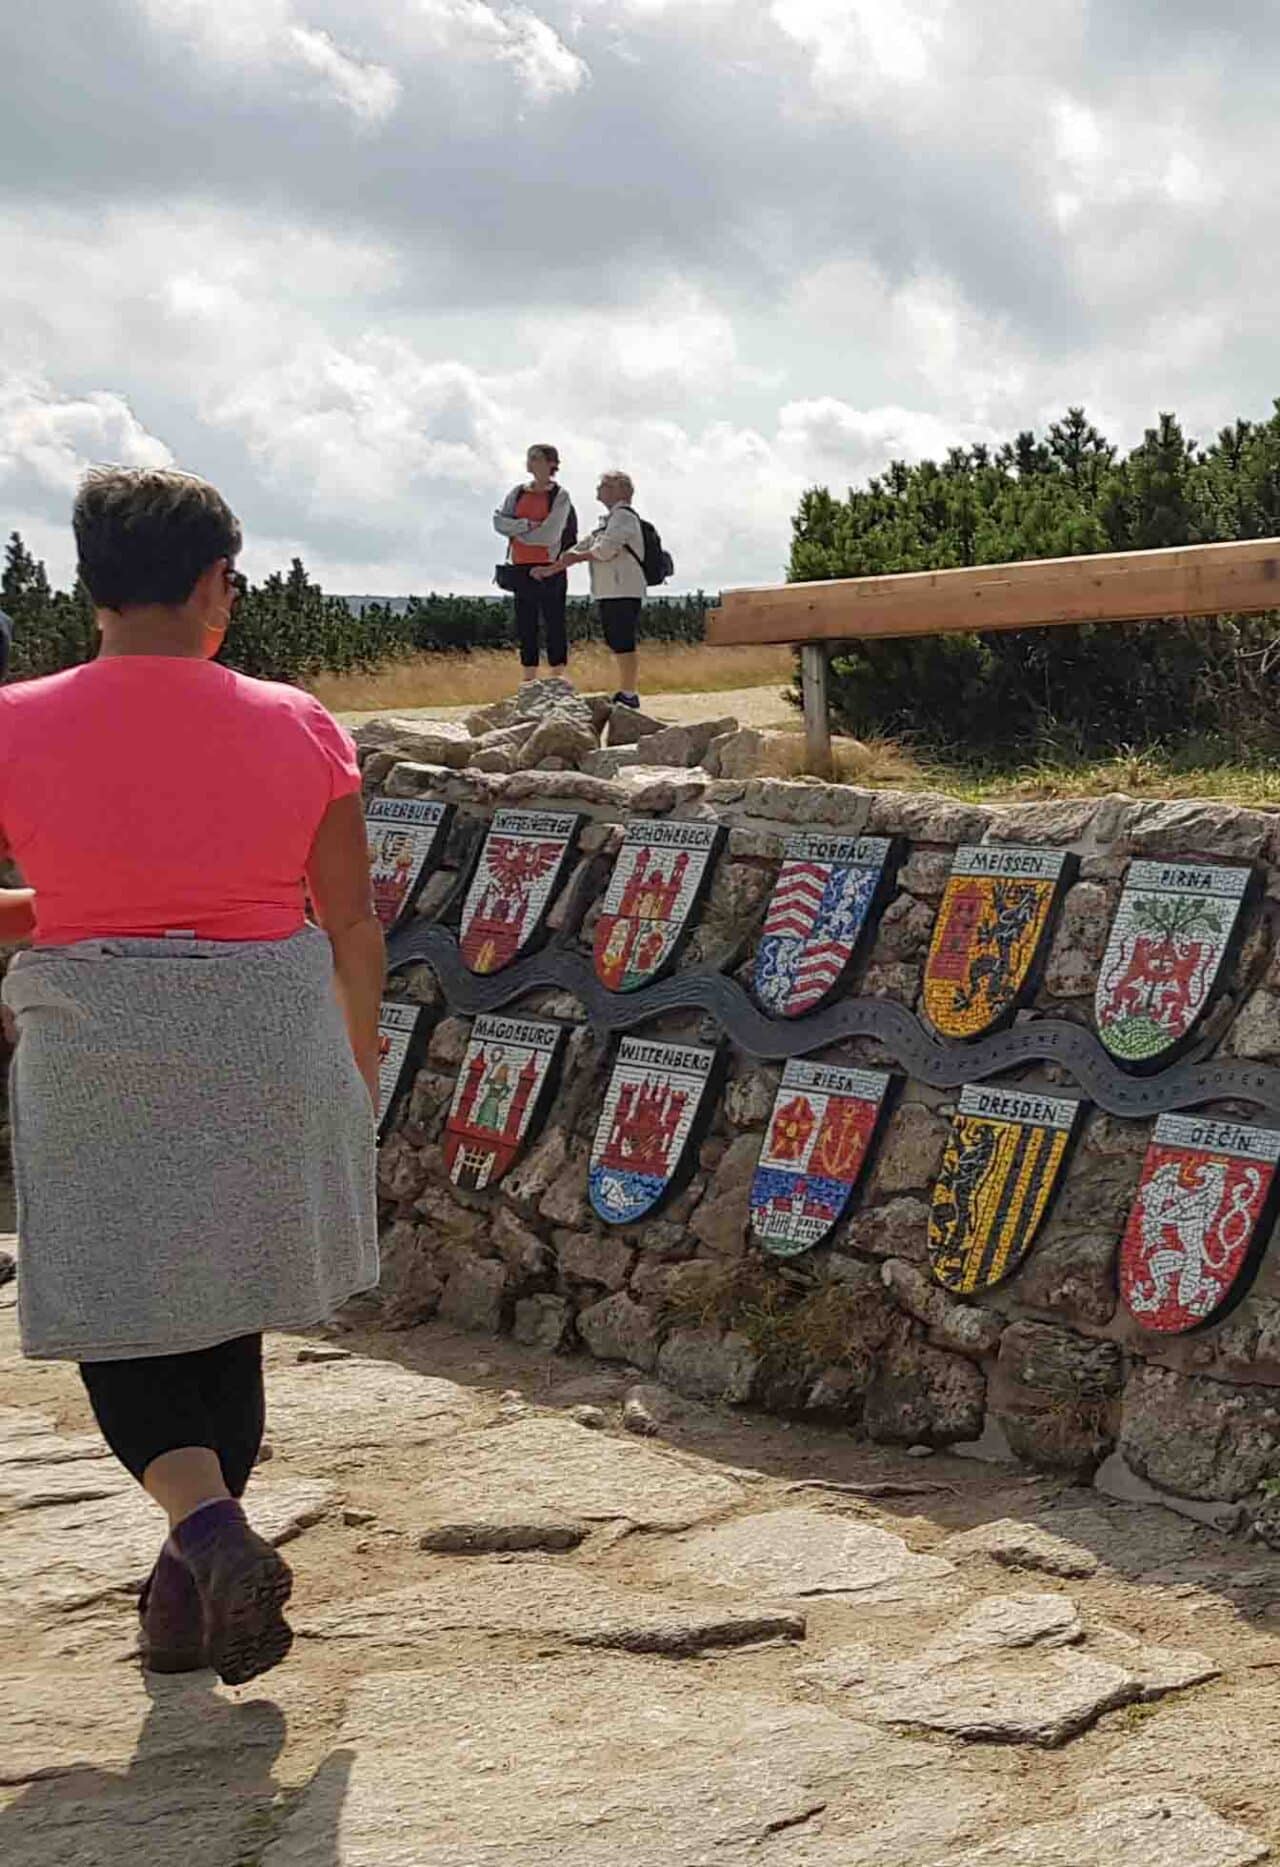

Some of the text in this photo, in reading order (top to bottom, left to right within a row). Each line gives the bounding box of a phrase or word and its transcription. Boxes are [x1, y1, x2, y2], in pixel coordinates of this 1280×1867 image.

[969, 853, 1043, 873] MEISSEN
[1161, 868, 1212, 887] PIRNA
[620, 1043, 711, 1071] WITTENBERG
[812, 1071, 853, 1092] RIESA
[978, 1095, 1057, 1121] DRESDEN
